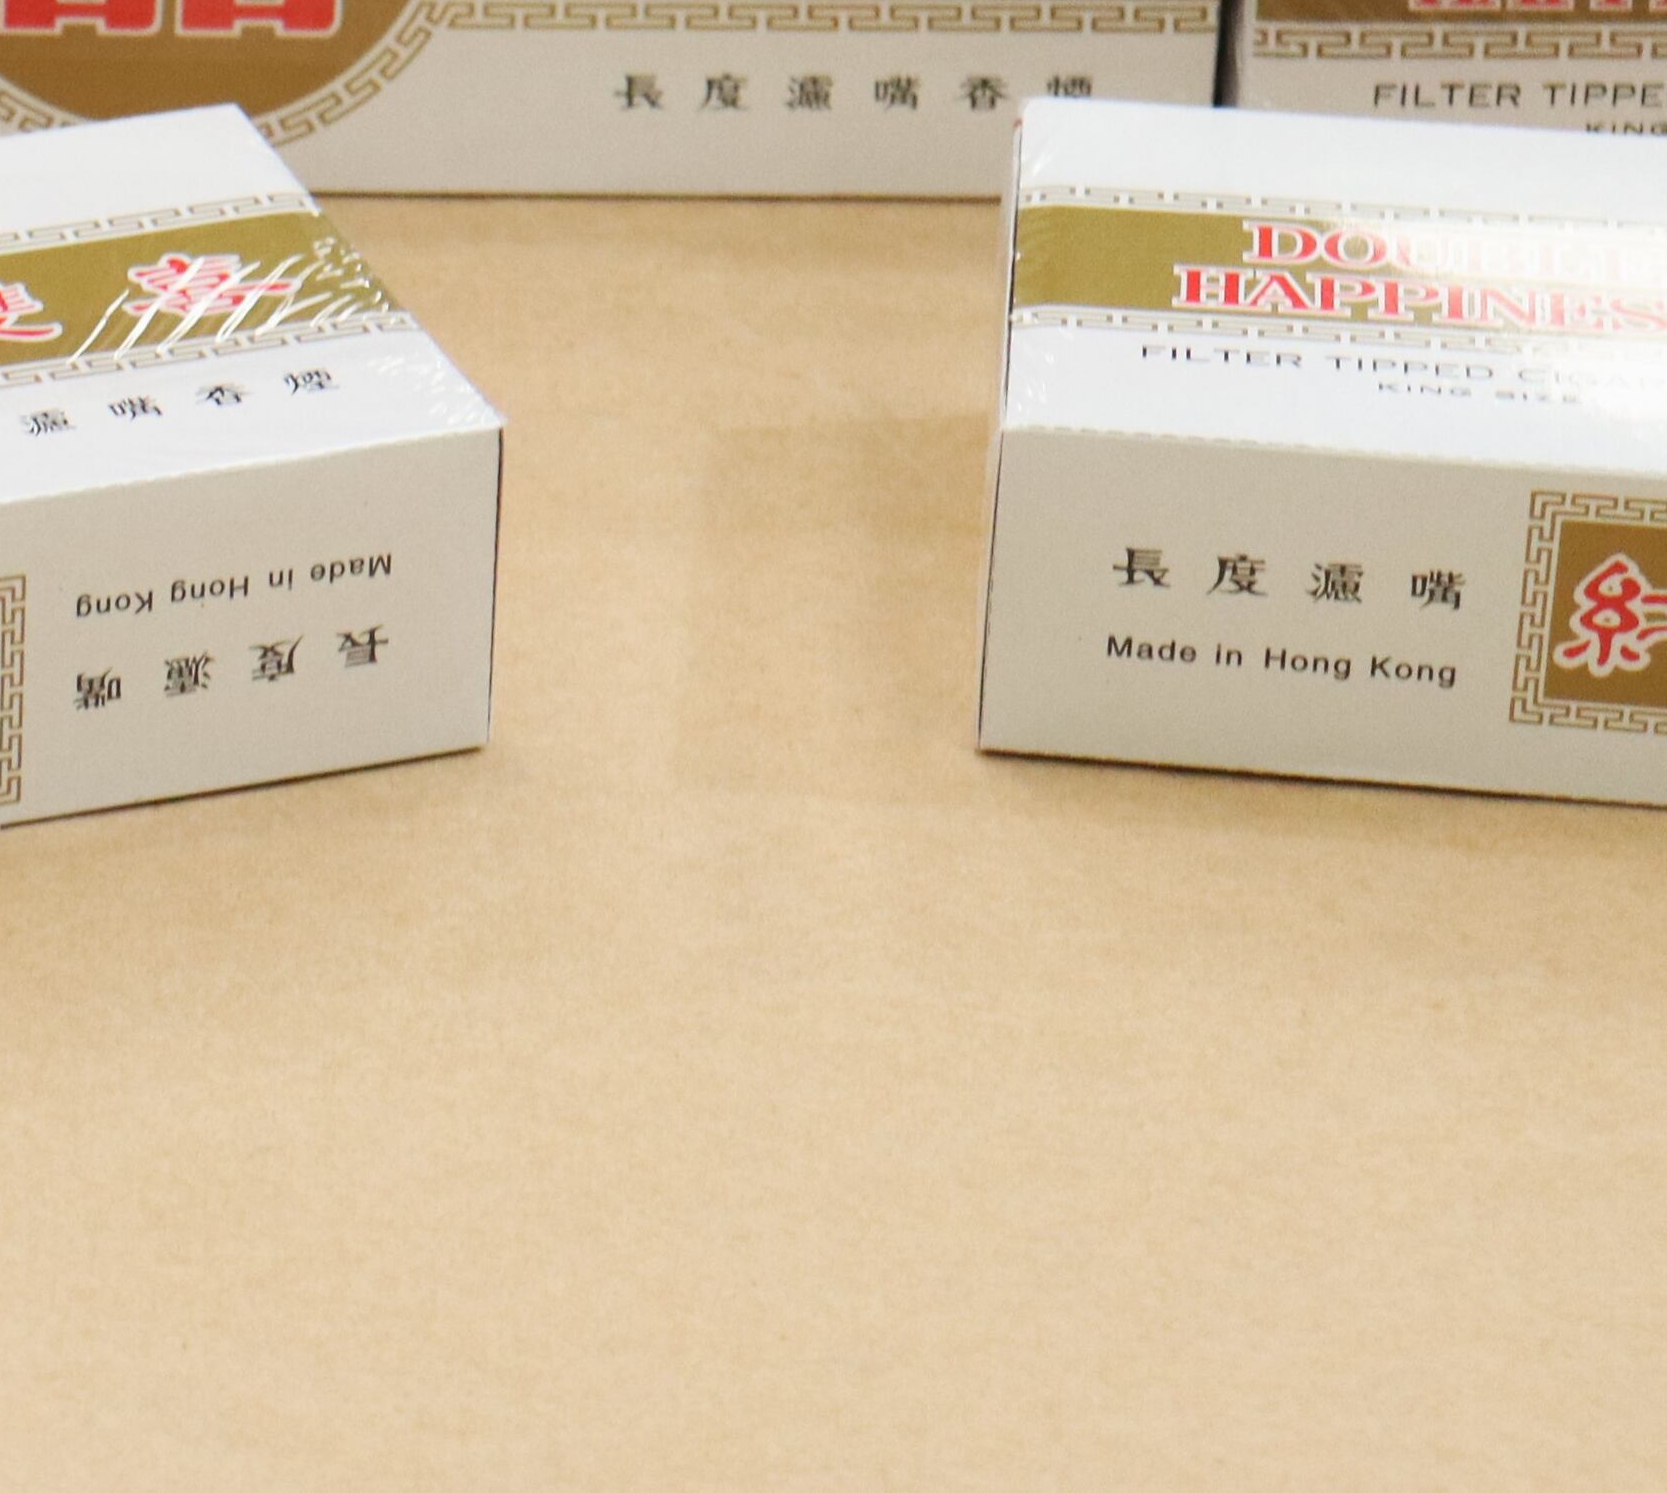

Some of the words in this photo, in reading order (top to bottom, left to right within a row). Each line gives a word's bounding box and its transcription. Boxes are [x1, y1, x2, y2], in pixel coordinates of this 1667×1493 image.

[1372, 81, 1522, 108] FILTER
[1542, 82, 1665, 108] TIPPE
[1141, 345, 1303, 367] FILTER
[1326, 355, 1495, 379] TIPPED
[1377, 382, 1472, 397] KING
[268, 568, 294, 591] in
[309, 552, 393, 585] Made
[1112, 546, 1466, 611] 長度濾嘴
[75, 589, 155, 620] Kong
[170, 574, 251, 604] Hong
[74, 625, 391, 711] 長度濾嘴
[1106, 634, 1197, 664] Made
[1215, 643, 1243, 667] in
[1264, 646, 1352, 681] Hong
[1369, 655, 1457, 689] Kong
